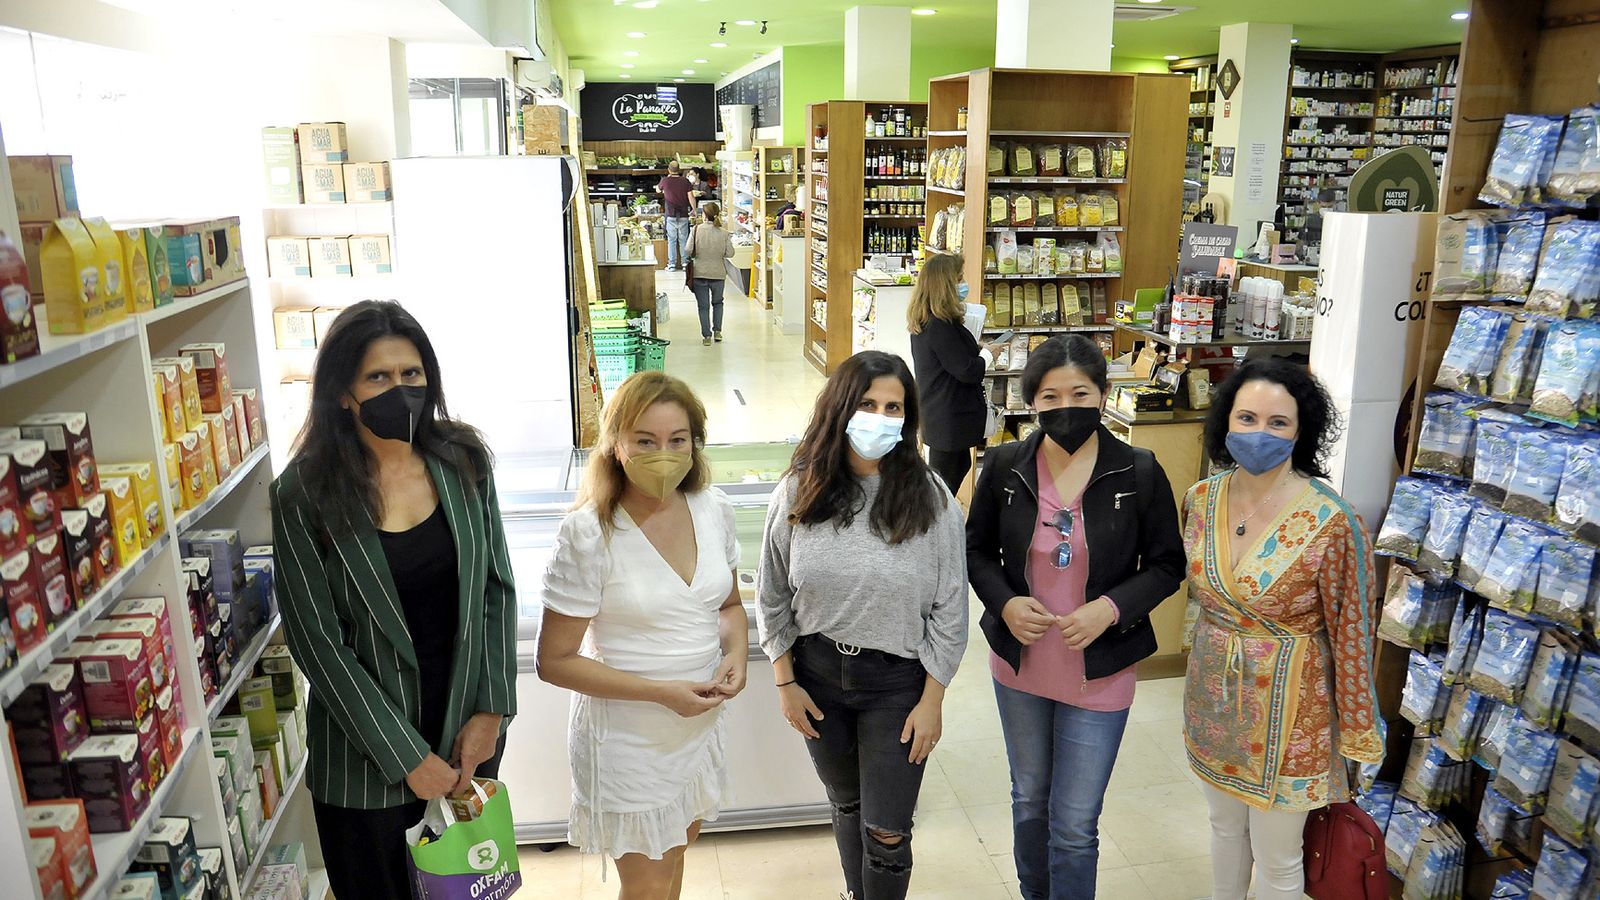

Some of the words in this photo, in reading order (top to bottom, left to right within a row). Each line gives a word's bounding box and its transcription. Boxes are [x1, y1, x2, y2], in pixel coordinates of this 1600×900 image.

[619, 102, 634, 114] La
[636, 100, 678, 114] Panacea
[311, 128, 331, 139] AGUA
[316, 139, 332, 148] MAR
[314, 168, 334, 179] AGUA
[356, 168, 376, 178] AGUA
[319, 179, 335, 188] MAR
[361, 178, 377, 187] MAR
[470, 860, 509, 899] OXFAM
